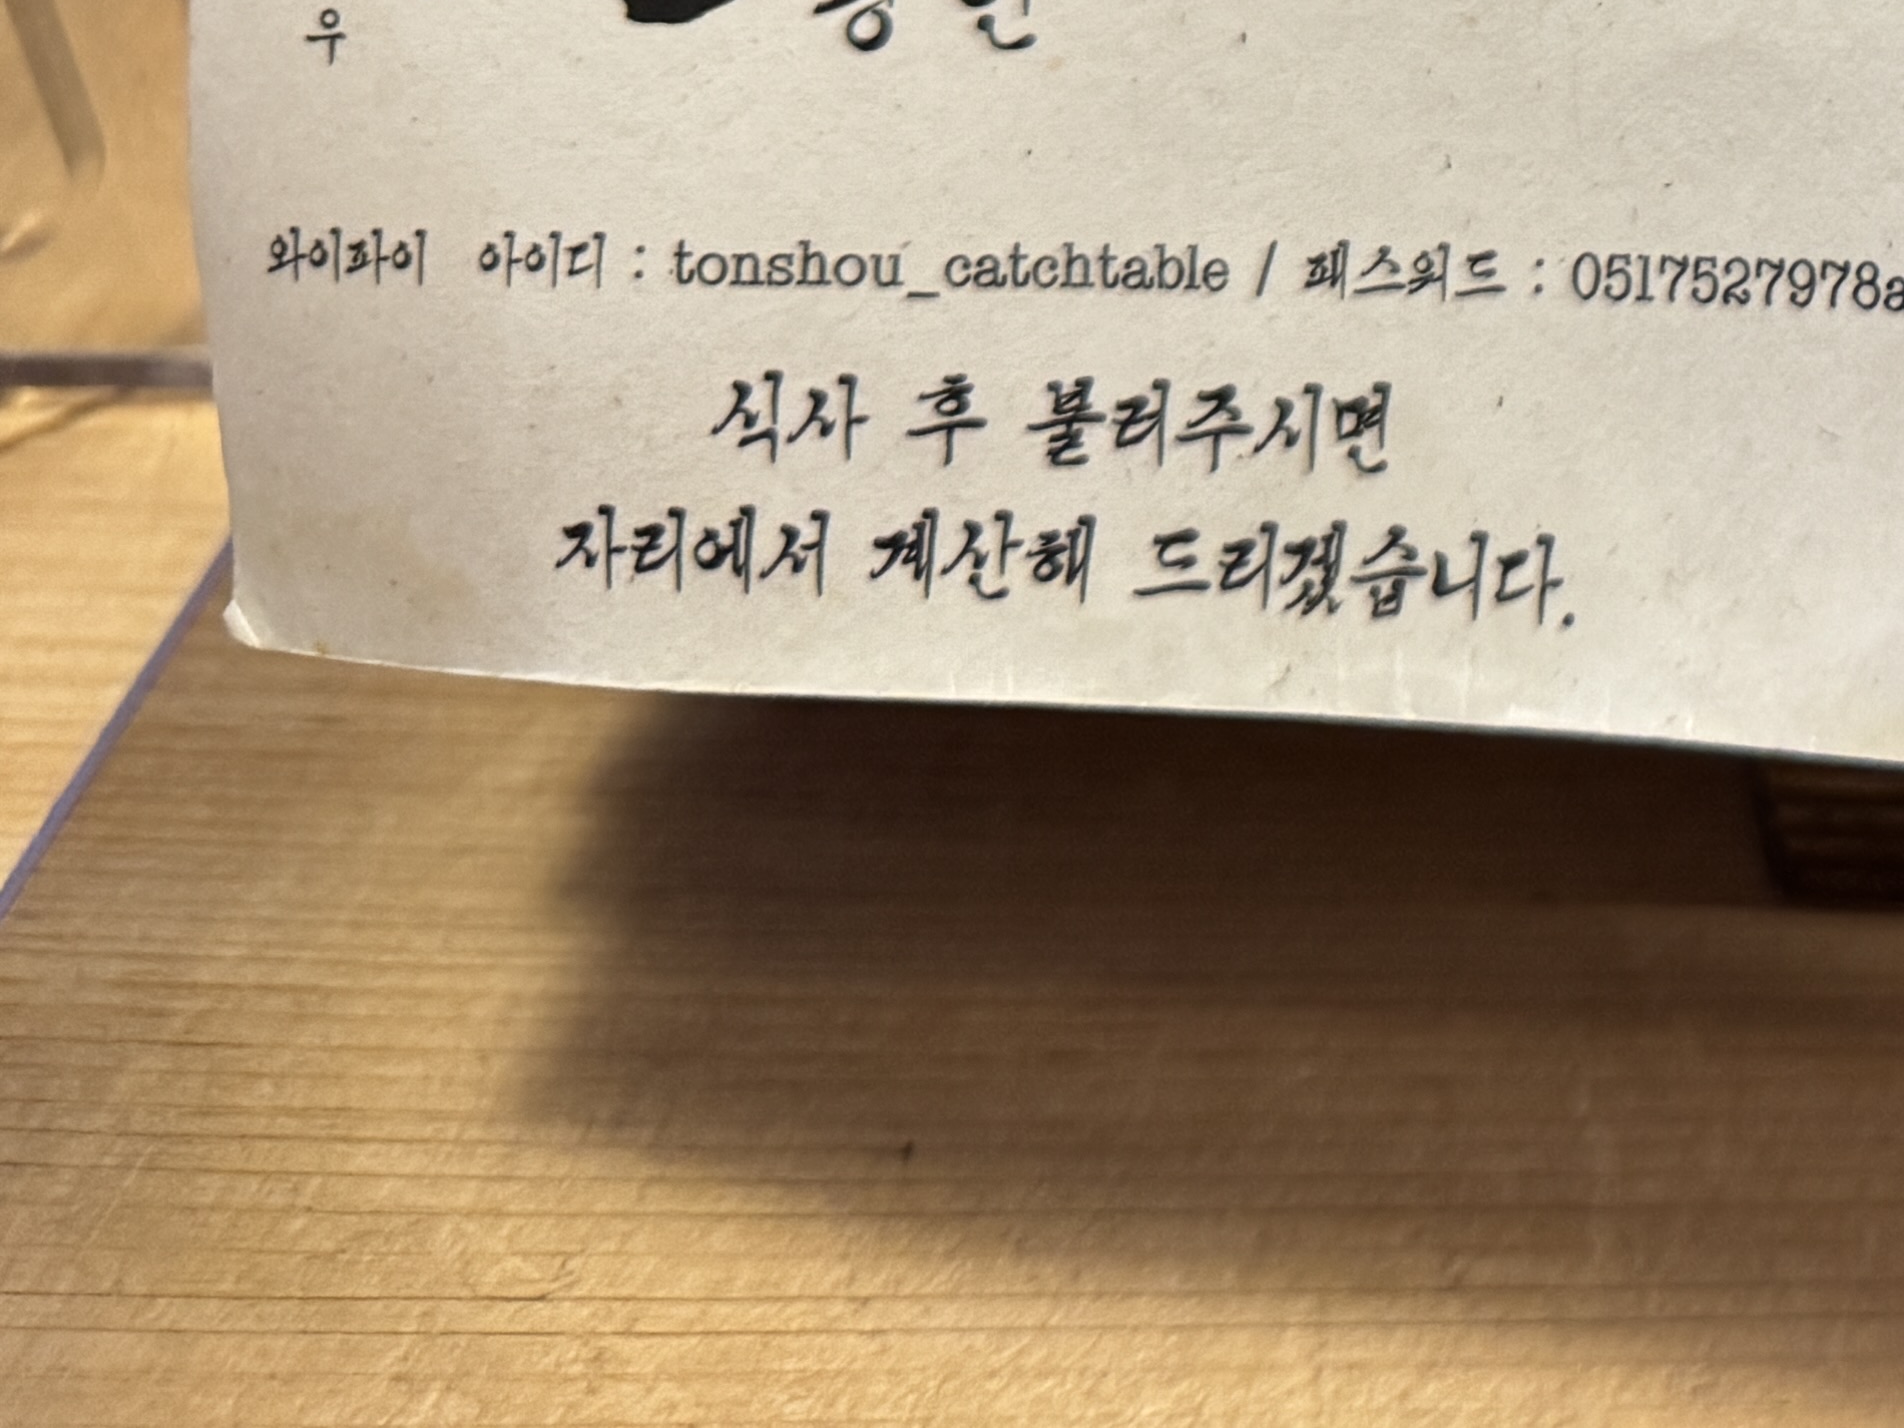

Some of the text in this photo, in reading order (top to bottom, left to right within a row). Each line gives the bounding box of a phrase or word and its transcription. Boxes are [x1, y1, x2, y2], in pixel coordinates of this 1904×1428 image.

[267, 226, 427, 286] 와이파이
[478, 230, 606, 289] 아이디
[672, 239, 1229, 302] tonshou_catchtable
[1301, 239, 1507, 302] 패스워드
[709, 369, 1392, 479] 식사 후 불러주시면
[554, 504, 1575, 630] 자리에서 계산해 드리겠습니다.
